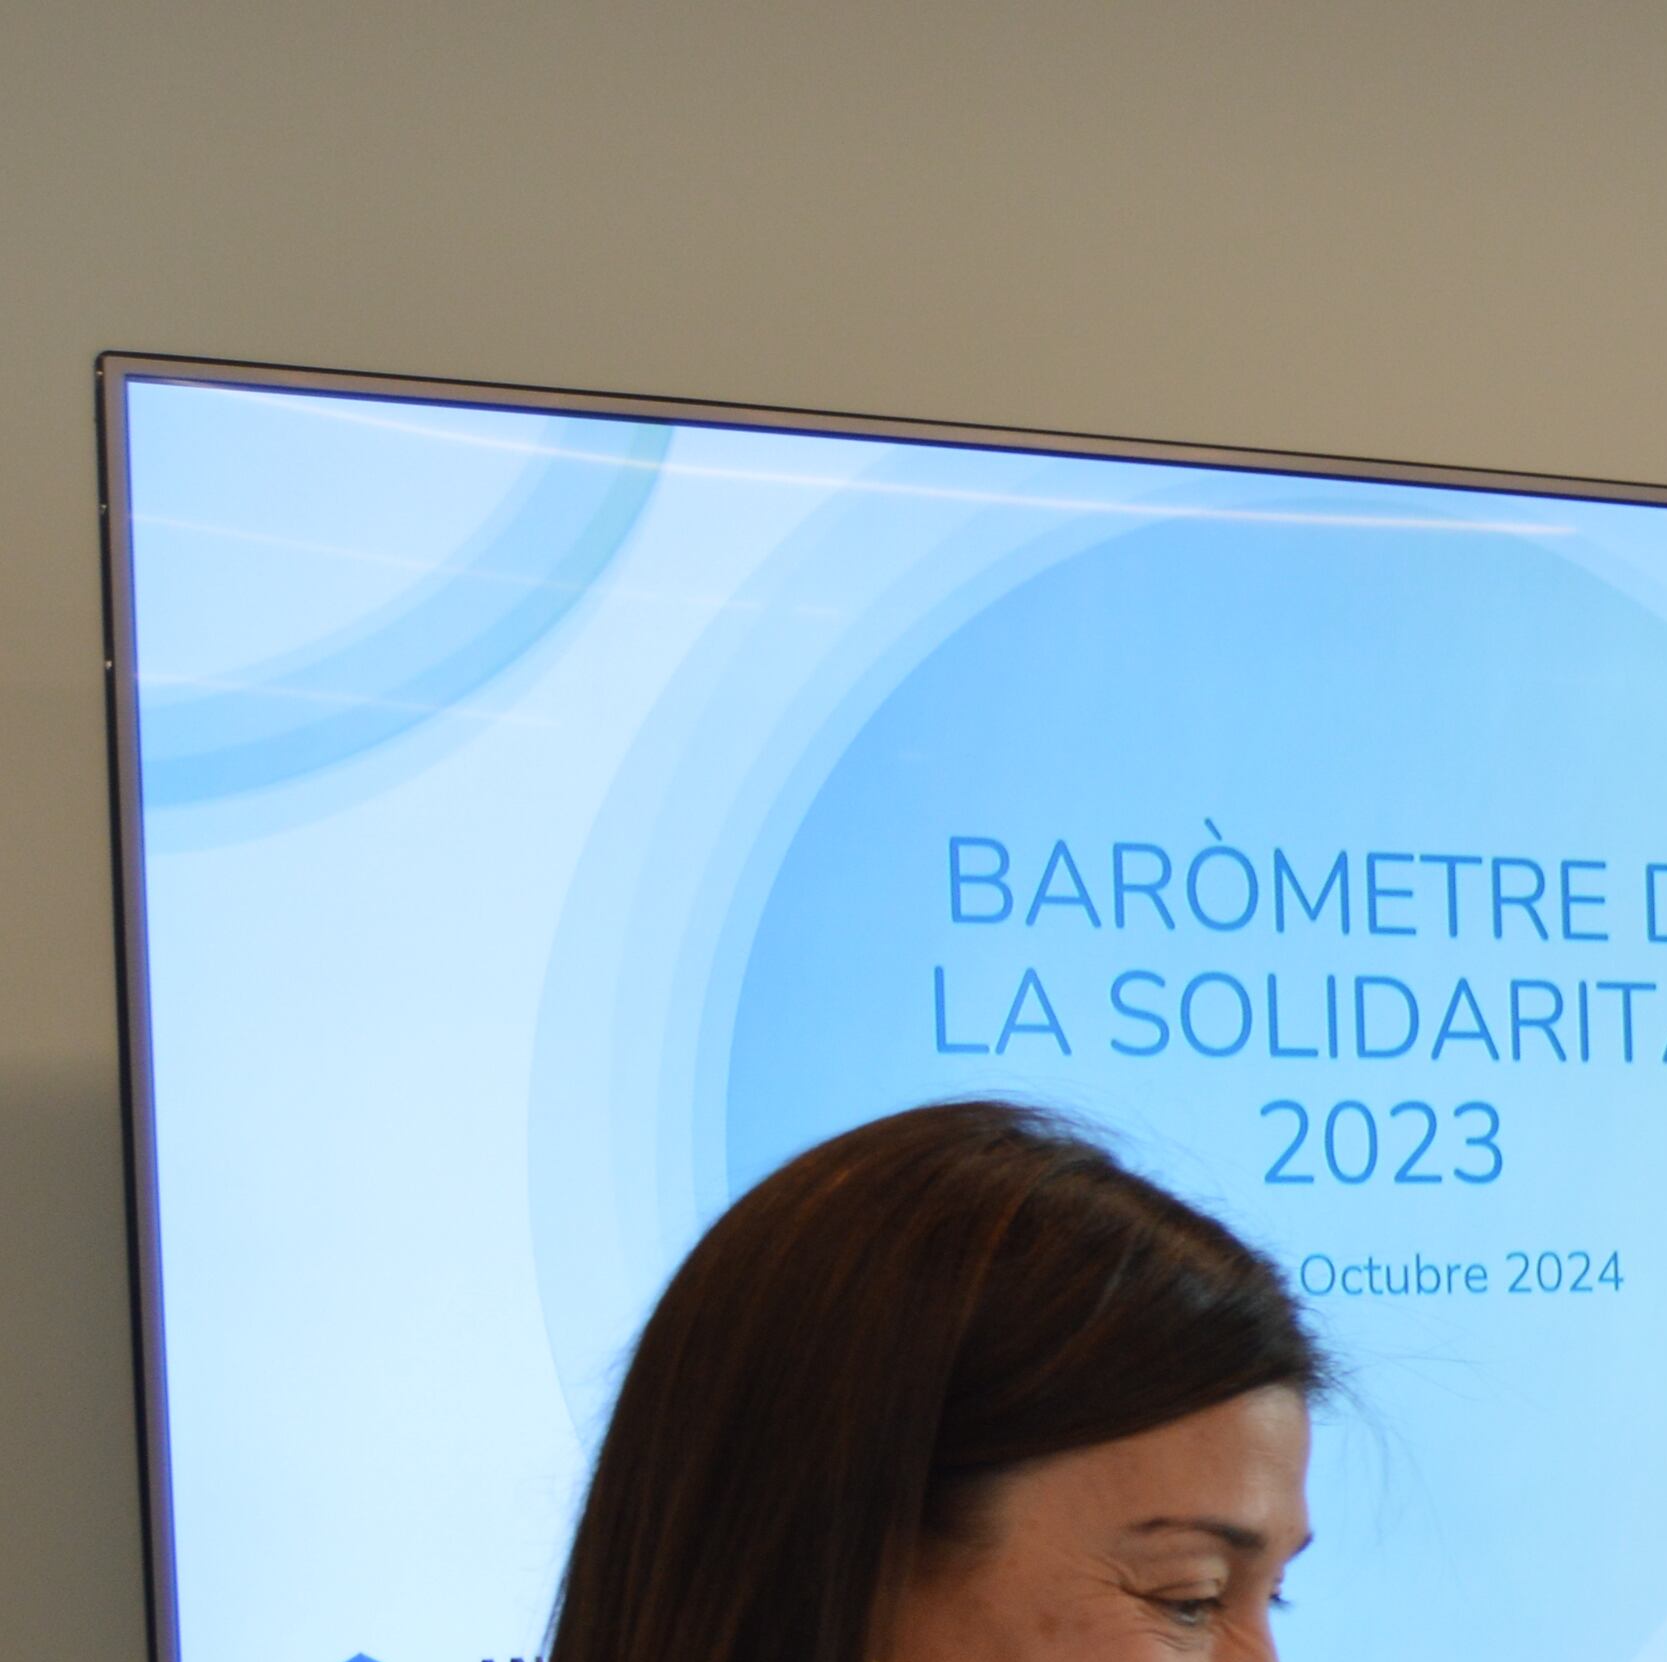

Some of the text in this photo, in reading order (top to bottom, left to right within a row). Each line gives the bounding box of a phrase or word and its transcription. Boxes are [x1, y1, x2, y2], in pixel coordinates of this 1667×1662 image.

[947, 817, 1609, 942] BARÒMETRE
[932, 965, 1073, 1057] LA
[1258, 1098, 1505, 1186] 2023
[1298, 1250, 1625, 1297] Octubre 2024
